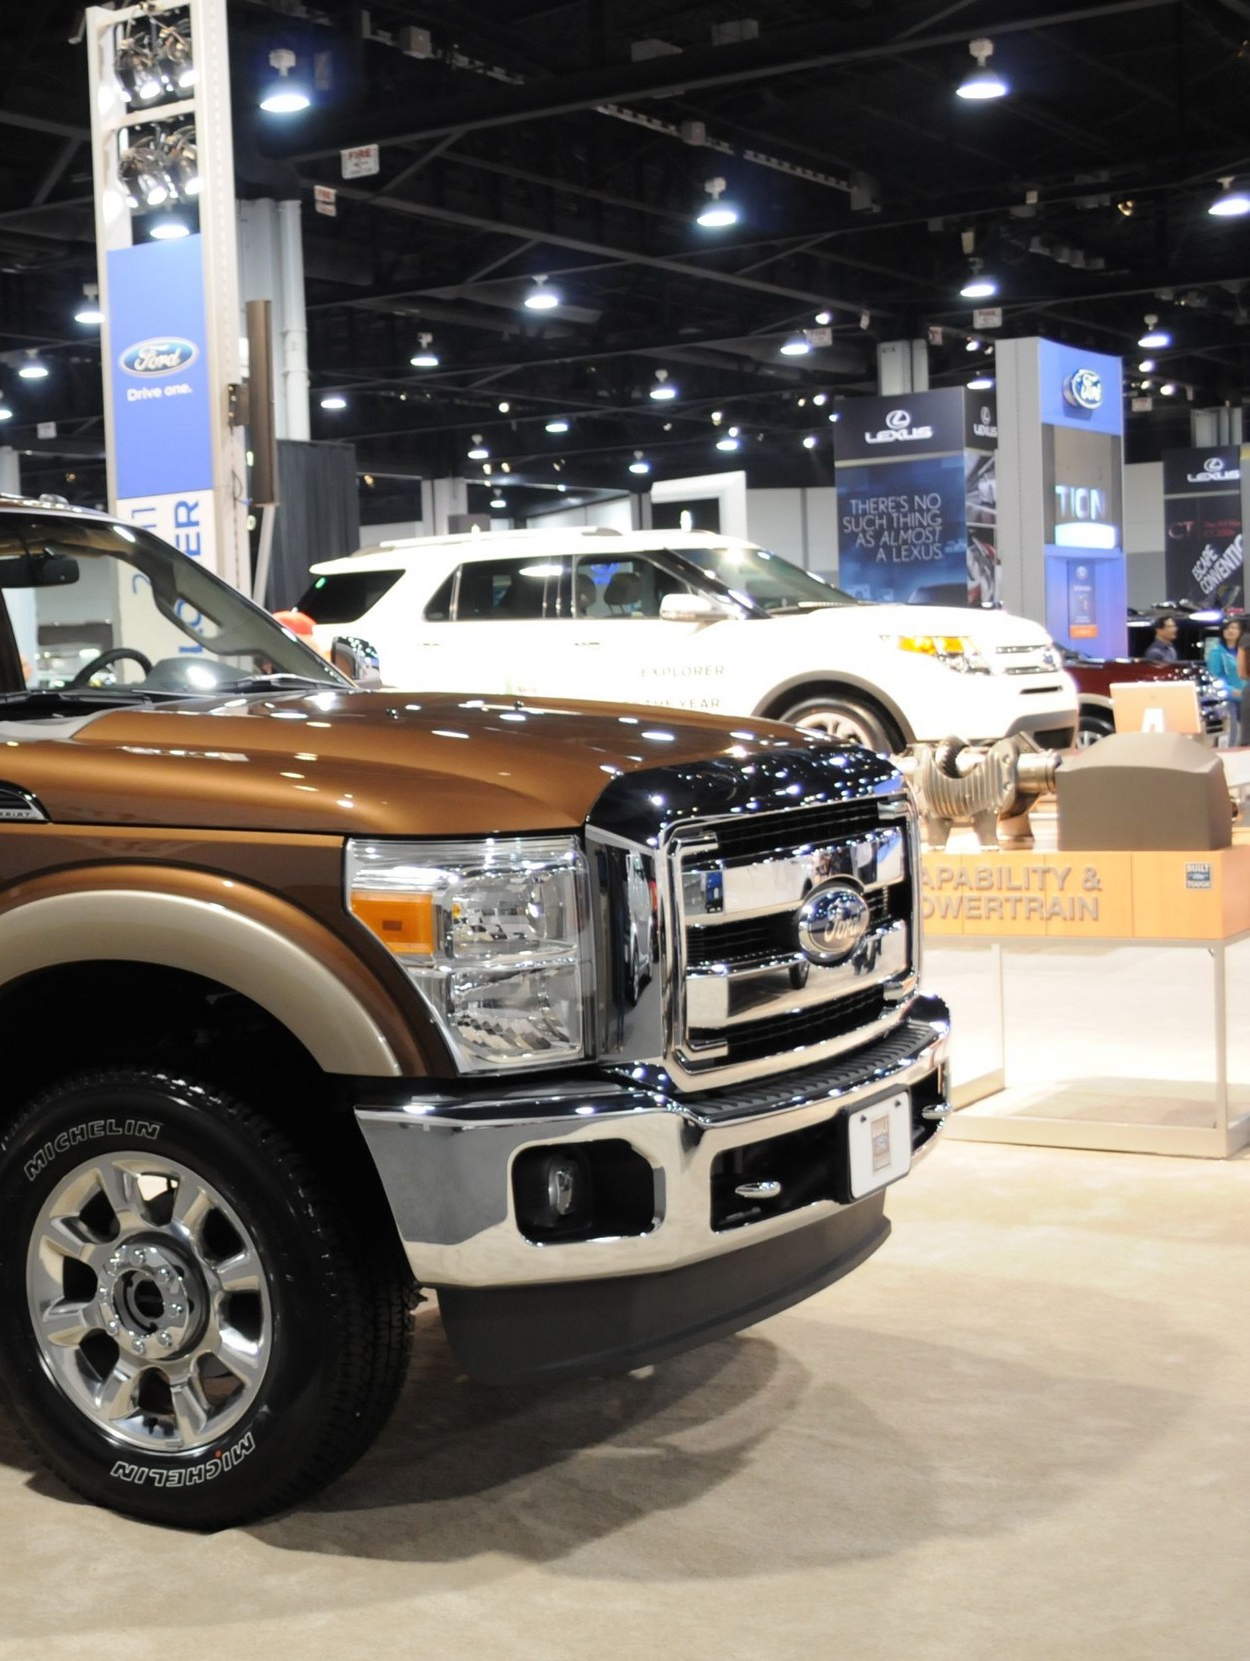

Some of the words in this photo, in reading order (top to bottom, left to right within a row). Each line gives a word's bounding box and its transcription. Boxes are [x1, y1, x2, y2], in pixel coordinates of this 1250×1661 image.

[348, 148, 371, 160] FIRE
[126, 387, 162, 402] Drive
[164, 383, 193, 396] one.
[864, 425, 934, 444] LEXUS
[1186, 469, 1240, 483] LEXUS
[850, 495, 909, 515] THERE'S
[914, 493, 942, 510] NO
[842, 513, 887, 533] SUCH
[891, 510, 942, 528] THING
[1168, 520, 1194, 539] CT
[855, 531, 875, 548] AS
[879, 526, 942, 546] ALMOST
[131, 507, 157, 595] 211
[875, 547, 887, 563] A
[1192, 543, 1219, 582] ESCAPE
[640, 664, 725, 678] EXPLORER
[678, 698, 720, 709] YEAR
[922, 865, 1072, 892] APABILITY
[1081, 865, 1103, 892] &
[922, 895, 1100, 922] OWERTRAIN
[23, 1118, 161, 1182] MICHELIN
[109, 1431, 256, 1488] MICHELIN
